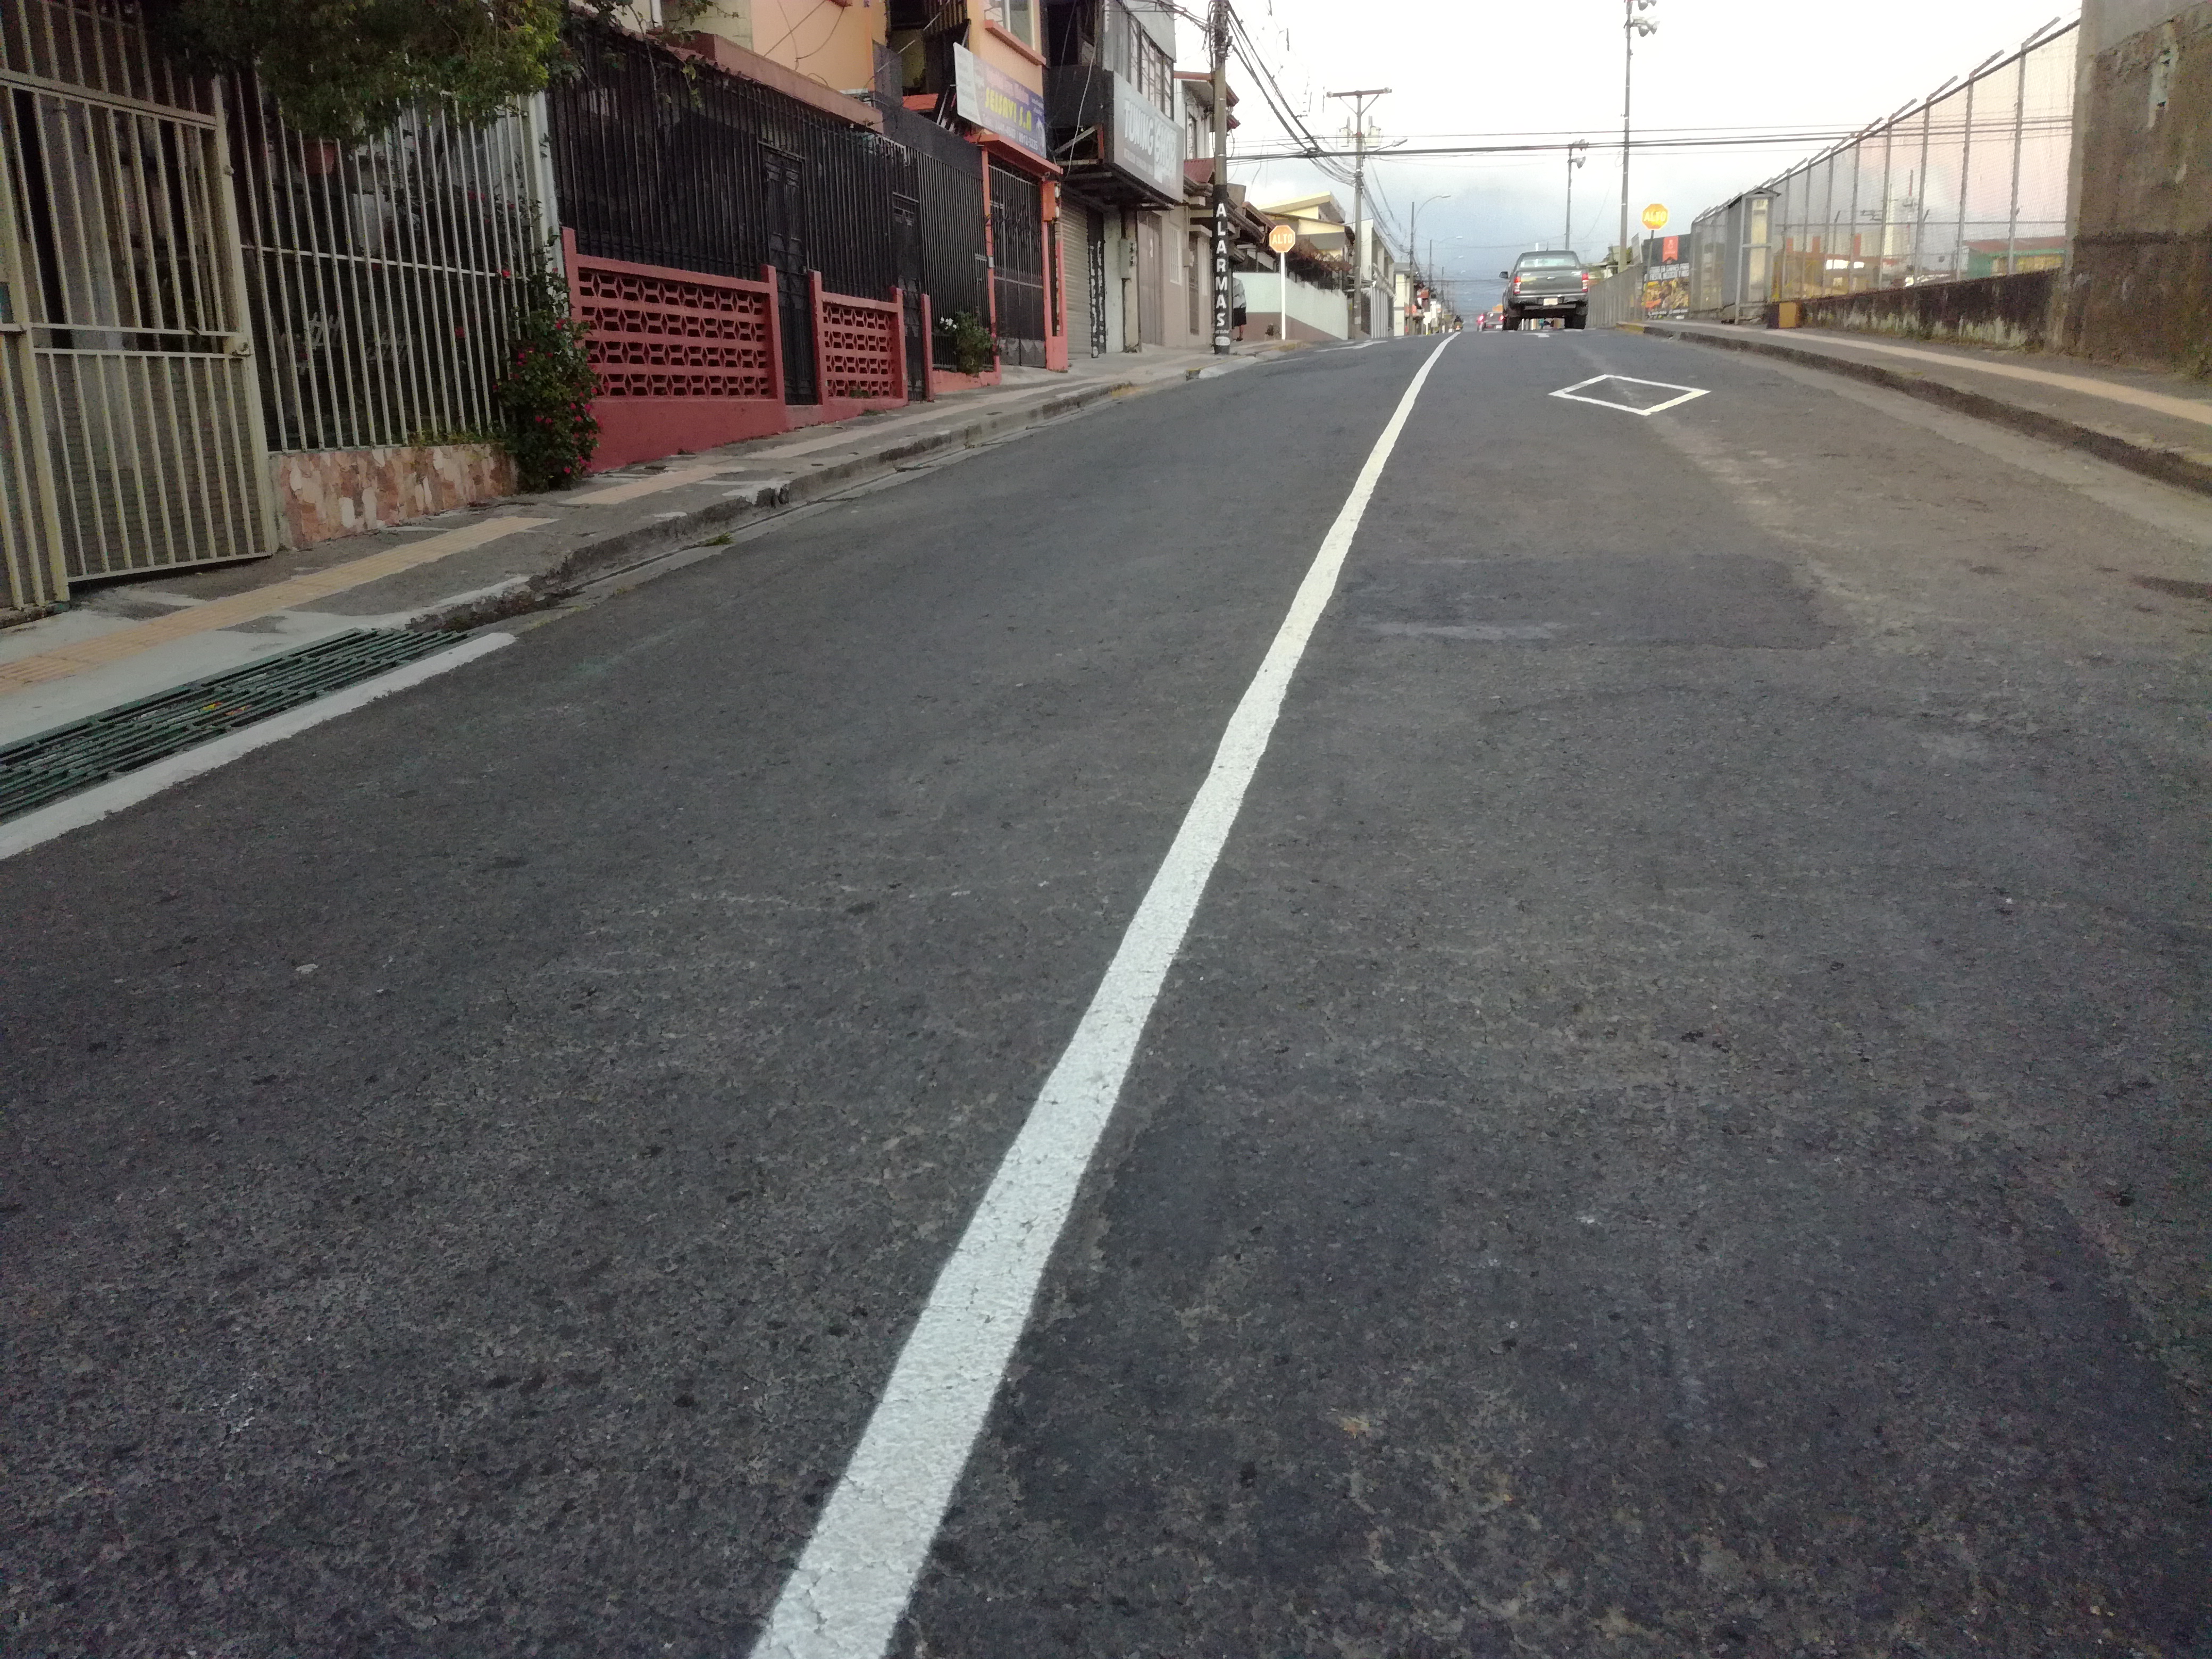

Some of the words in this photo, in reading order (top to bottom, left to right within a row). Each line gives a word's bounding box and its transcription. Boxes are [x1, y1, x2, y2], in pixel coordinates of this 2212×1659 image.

[985, 87, 1016, 123] SEISAVI
[1125, 99, 1153, 155] TUNING
[1155, 118, 1176, 171] SHOP
[1644, 211, 1666, 222] ALTO
[1272, 234, 1292, 244] ALTO
[1216, 203, 1227, 326] ALARMAS
